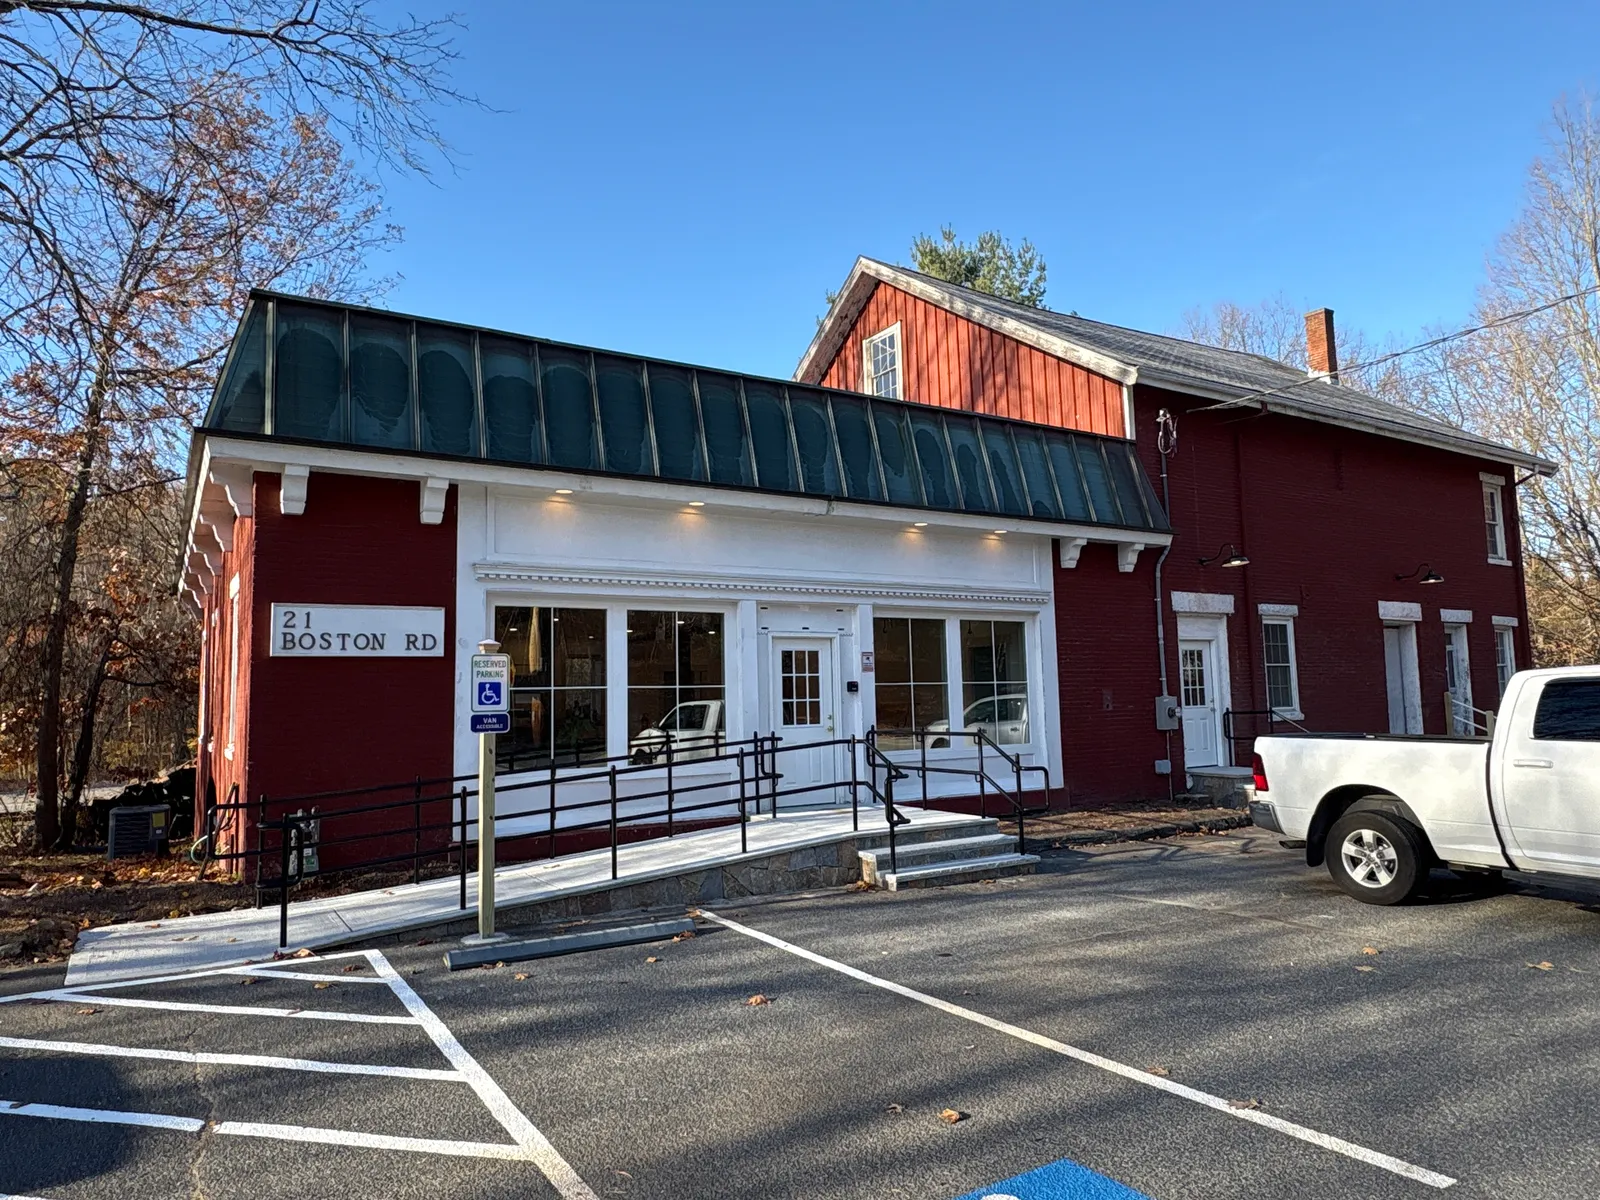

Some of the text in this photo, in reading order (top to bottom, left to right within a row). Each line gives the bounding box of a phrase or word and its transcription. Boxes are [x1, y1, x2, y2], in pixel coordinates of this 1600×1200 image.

[283, 611, 311, 629] 21
[281, 632, 437, 651] BOSTON RD
[474, 660, 507, 668] RESERVED
[476, 670, 504, 678] PARKING
